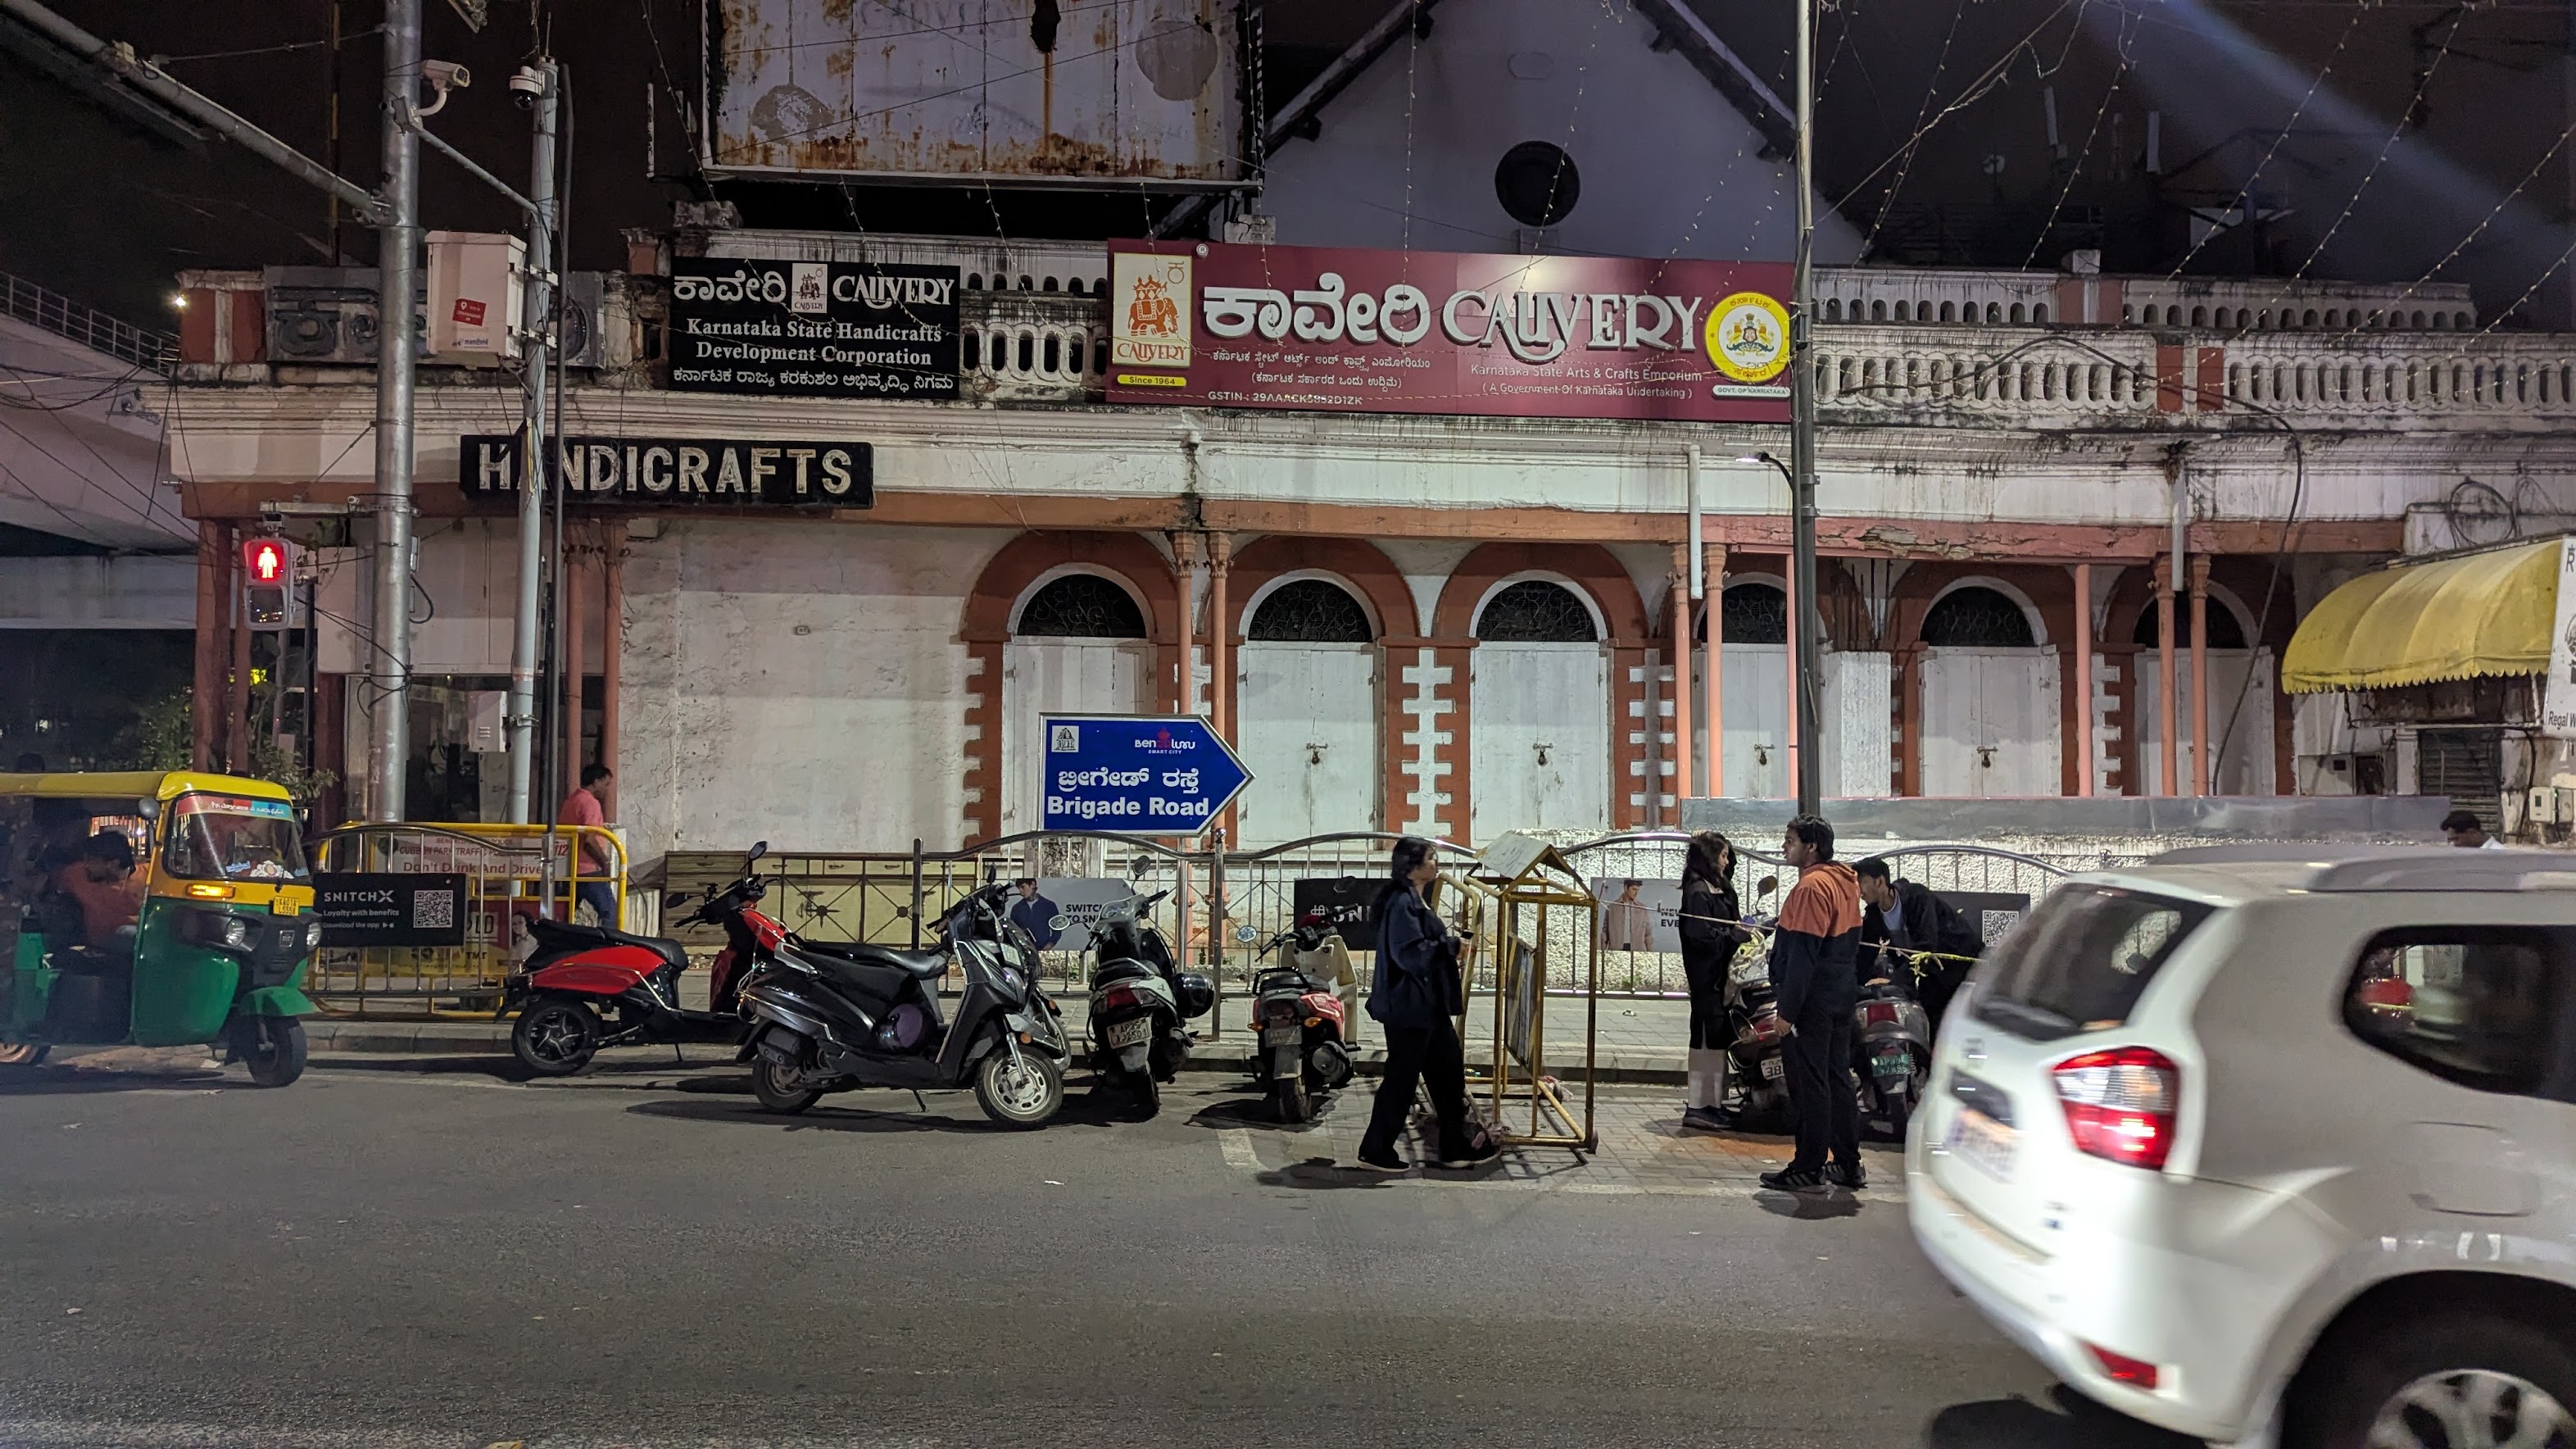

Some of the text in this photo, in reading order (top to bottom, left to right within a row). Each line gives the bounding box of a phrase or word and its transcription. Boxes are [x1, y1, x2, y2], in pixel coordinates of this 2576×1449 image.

[673, 270, 787, 302] ಕಾವೇರಿ
[832, 274, 955, 309] CAUVERY
[1203, 272, 1431, 345] ಕಾವೇರಿ
[687, 318, 942, 343] Karnataka State Handicrafts
[1442, 290, 1703, 364] CAUVERY
[696, 341, 932, 367] Development Corporation
[1117, 342, 1185, 362] CAUVERY
[1213, 350, 1250, 361] ಕರ್ನಾಟಕ
[673, 366, 732, 382] ಕರ್ನಾಟಕ
[737, 370, 775, 387] ರಾಜ್ಯ
[780, 370, 838, 385] ಕರಕುಶಲ
[914, 374, 954, 389] ನಿಗಮ
[1129, 376, 1176, 385] Since 1964
[1297, 374, 1335, 384] ಸರ್ಕಾರದ
[1339, 375, 1363, 386] ಒಂದು
[1471, 364, 1703, 383] Karnataka State Arts & Crafts Emporium
[1499, 383, 1558, 394] Government
[1562, 384, 1573, 394] Of
[1576, 385, 1623, 396] Karnataka
[1626, 386, 1686, 400] Undertaking
[478, 443, 852, 494] HNDICRAFTS
[2548, 711, 2569, 730] Regal
[1059, 766, 1200, 794] ಬ್ರೀಗೇಡ್ ರಸ್ತೆ
[1047, 796, 1209, 820] Brigade Road
[441, 862, 476, 874] Dink
[483, 863, 506, 874] And
